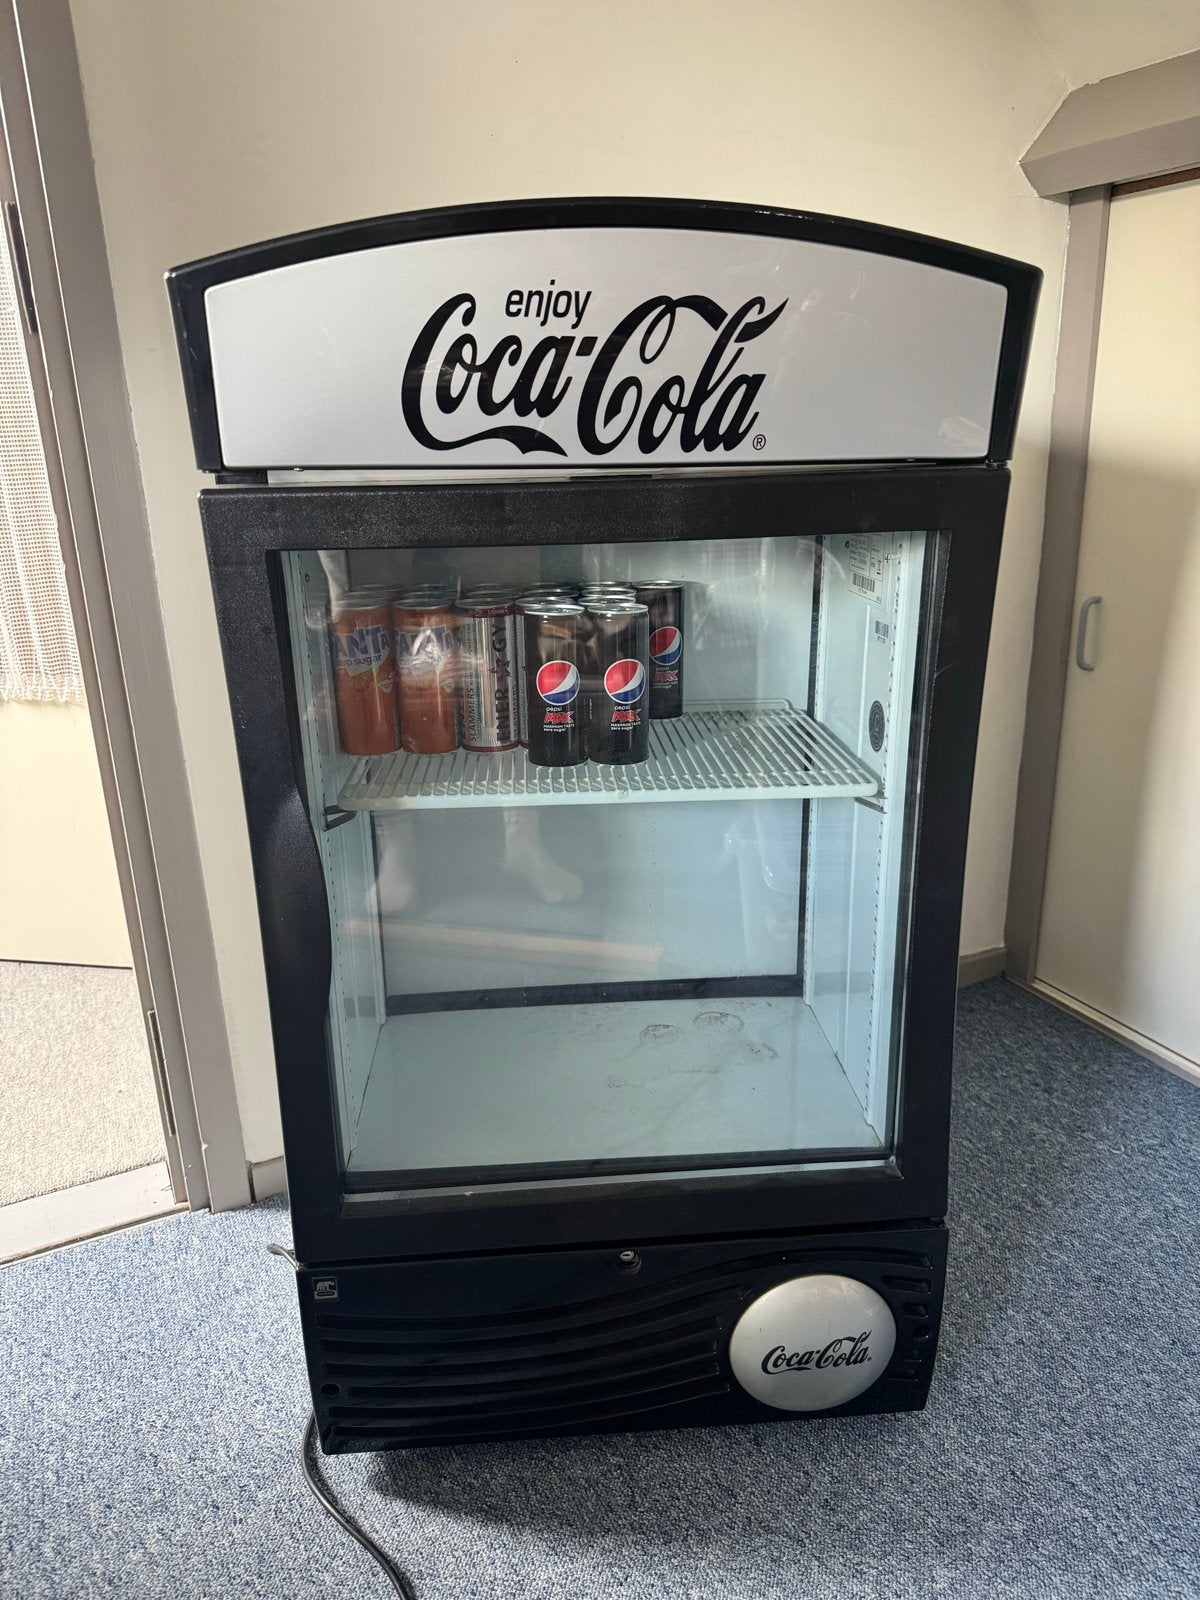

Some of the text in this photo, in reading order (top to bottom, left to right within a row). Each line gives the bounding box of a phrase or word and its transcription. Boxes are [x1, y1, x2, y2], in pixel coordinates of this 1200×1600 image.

[505, 279, 592, 329] enjoy
[401, 293, 789, 457] Coca-Cola
[333, 626, 390, 657] ANTA
[353, 654, 382, 667] sugar
[653, 670, 679, 681] MAX
[467, 687, 477, 742] SLAMMERS
[543, 711, 576, 724] MAX
[611, 709, 642, 722] MAX
[761, 1330, 872, 1374] Coca-Cola
